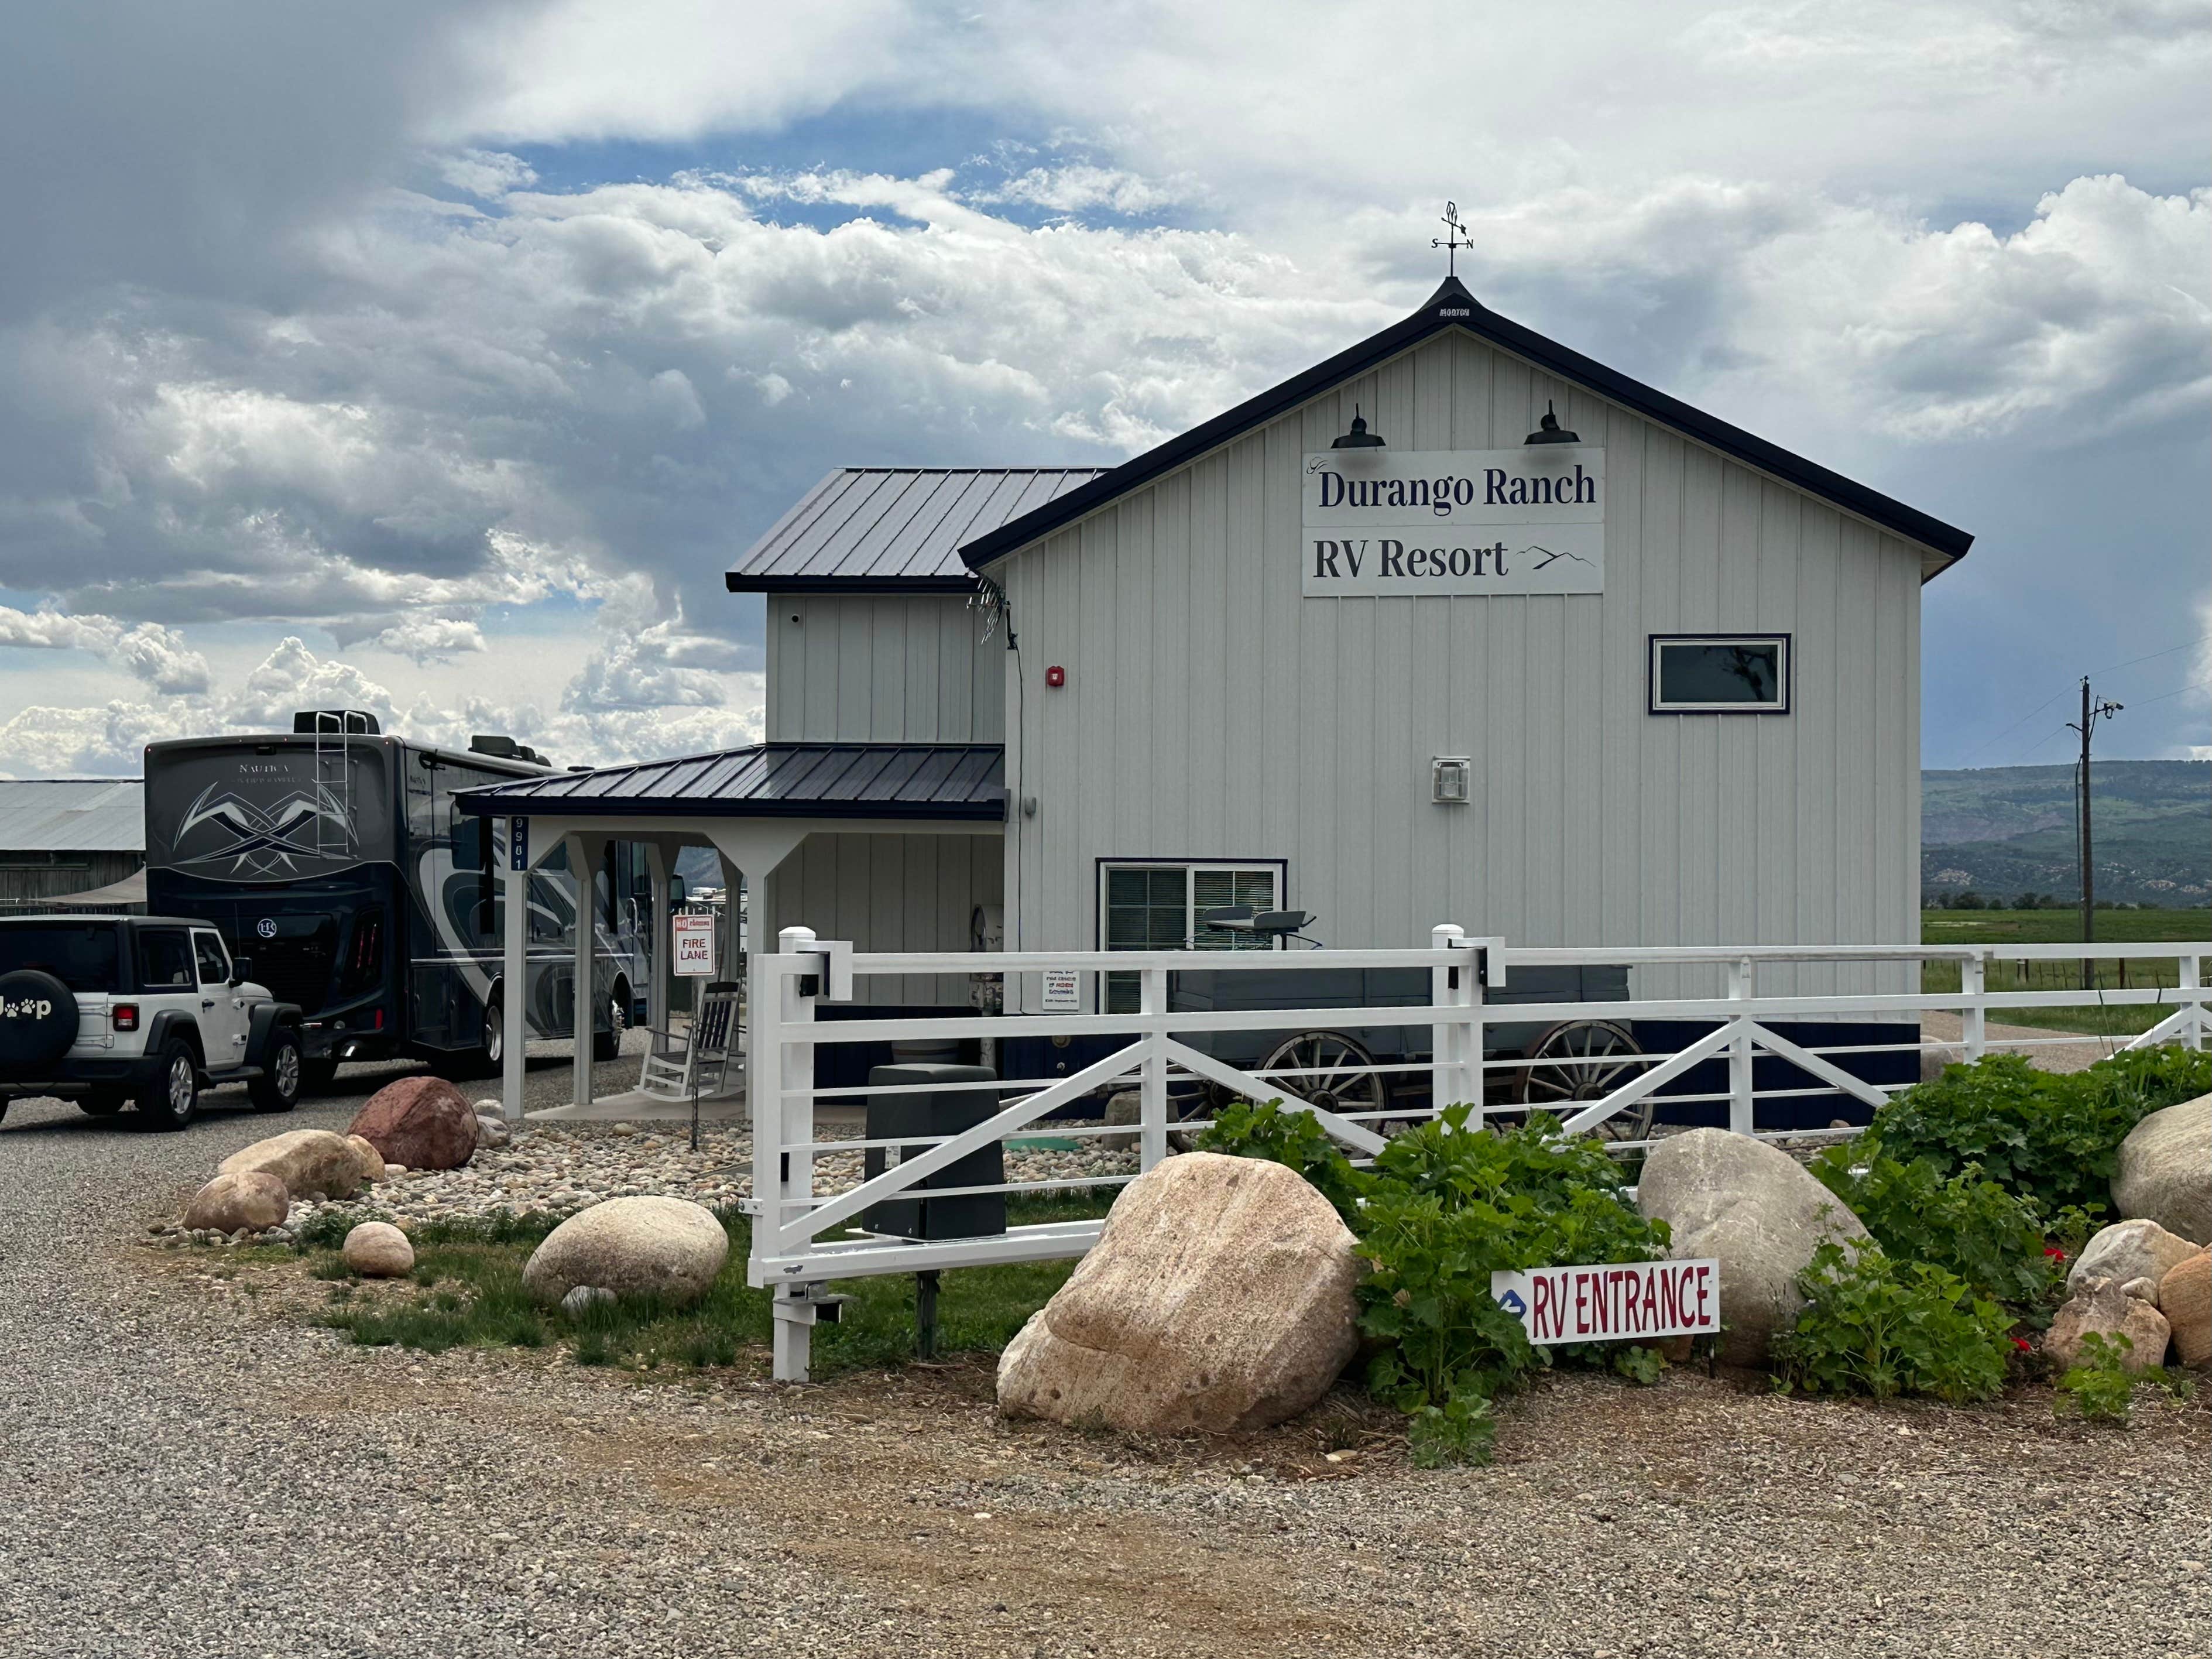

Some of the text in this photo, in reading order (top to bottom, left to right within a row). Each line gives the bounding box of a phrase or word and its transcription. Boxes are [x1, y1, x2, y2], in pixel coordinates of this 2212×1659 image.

[1318, 464, 1596, 516] Durango Ranch
[1313, 540, 1508, 578] RV Resort
[681, 950, 708, 960] LANE
[683, 939, 706, 948] FIRE
[1532, 1266, 1711, 1339] RV ENTRANCE
